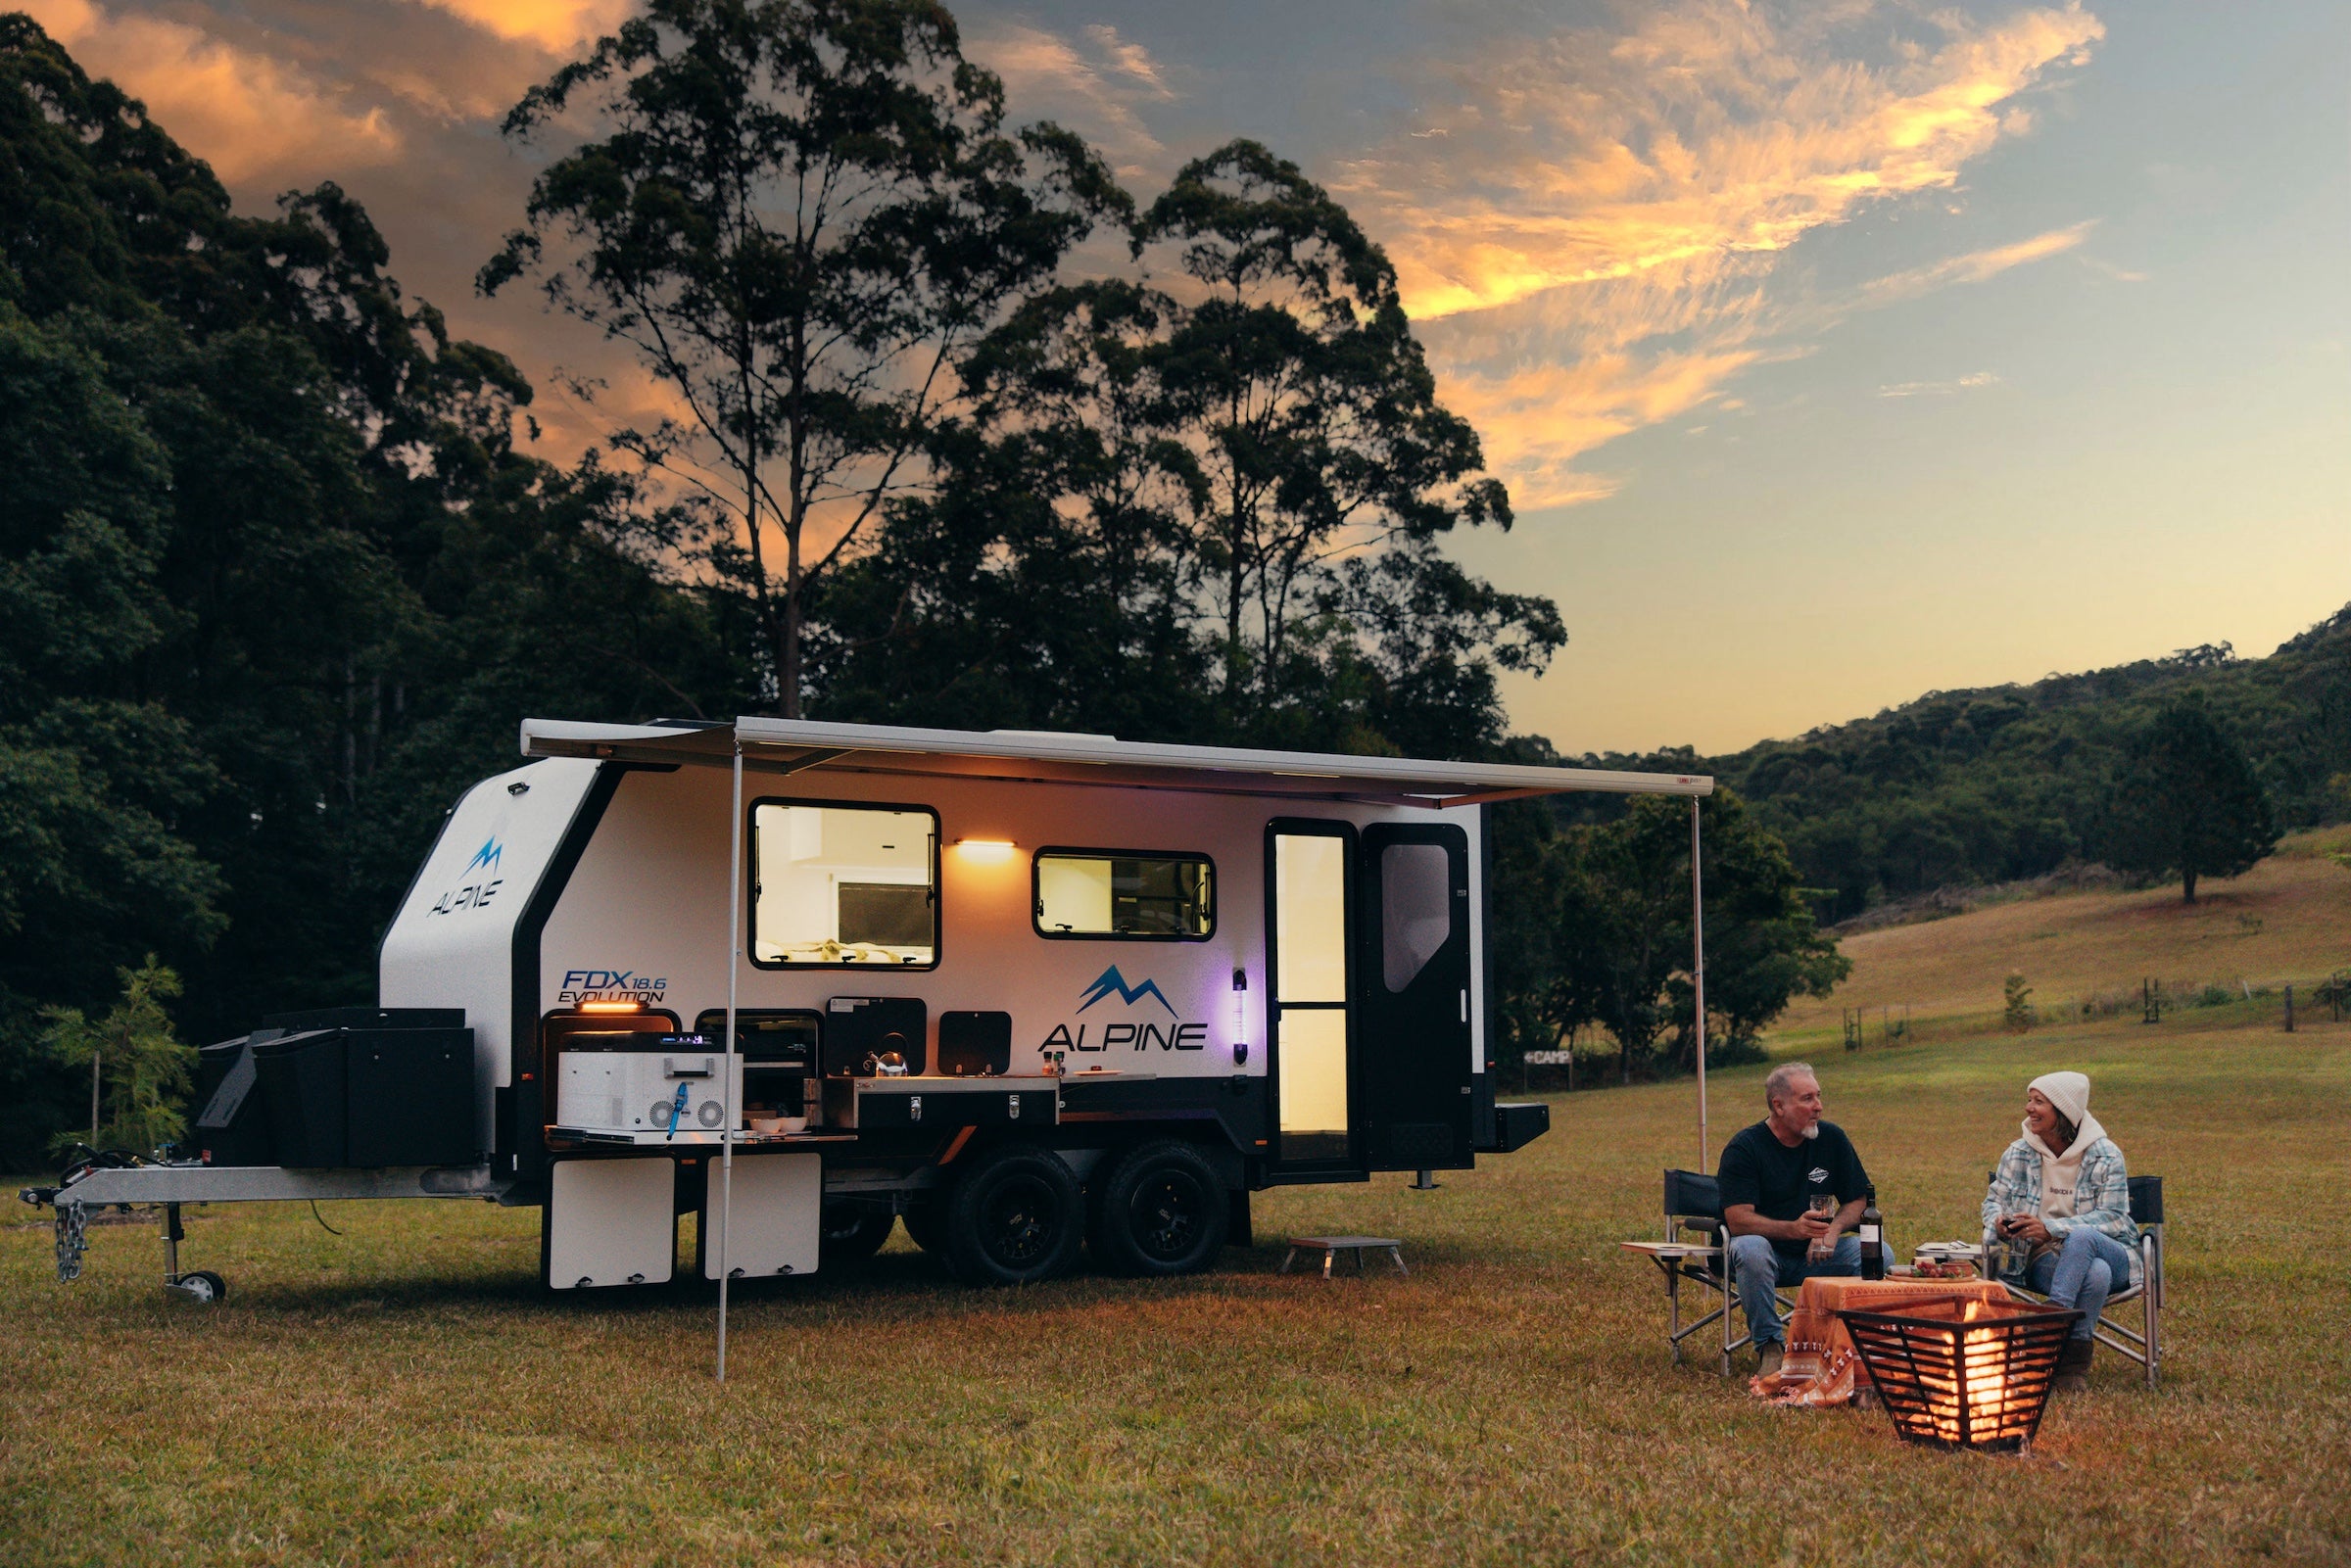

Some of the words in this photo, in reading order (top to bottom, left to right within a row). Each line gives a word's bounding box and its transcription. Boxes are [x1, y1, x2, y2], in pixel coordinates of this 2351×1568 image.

[426, 879, 504, 918] ALPINE
[633, 977, 667, 990] 18.6
[557, 991, 665, 1003] EVOLUTION
[1037, 1022, 1208, 1053] ALPINE
[1533, 1050, 1570, 1065] CAMP
